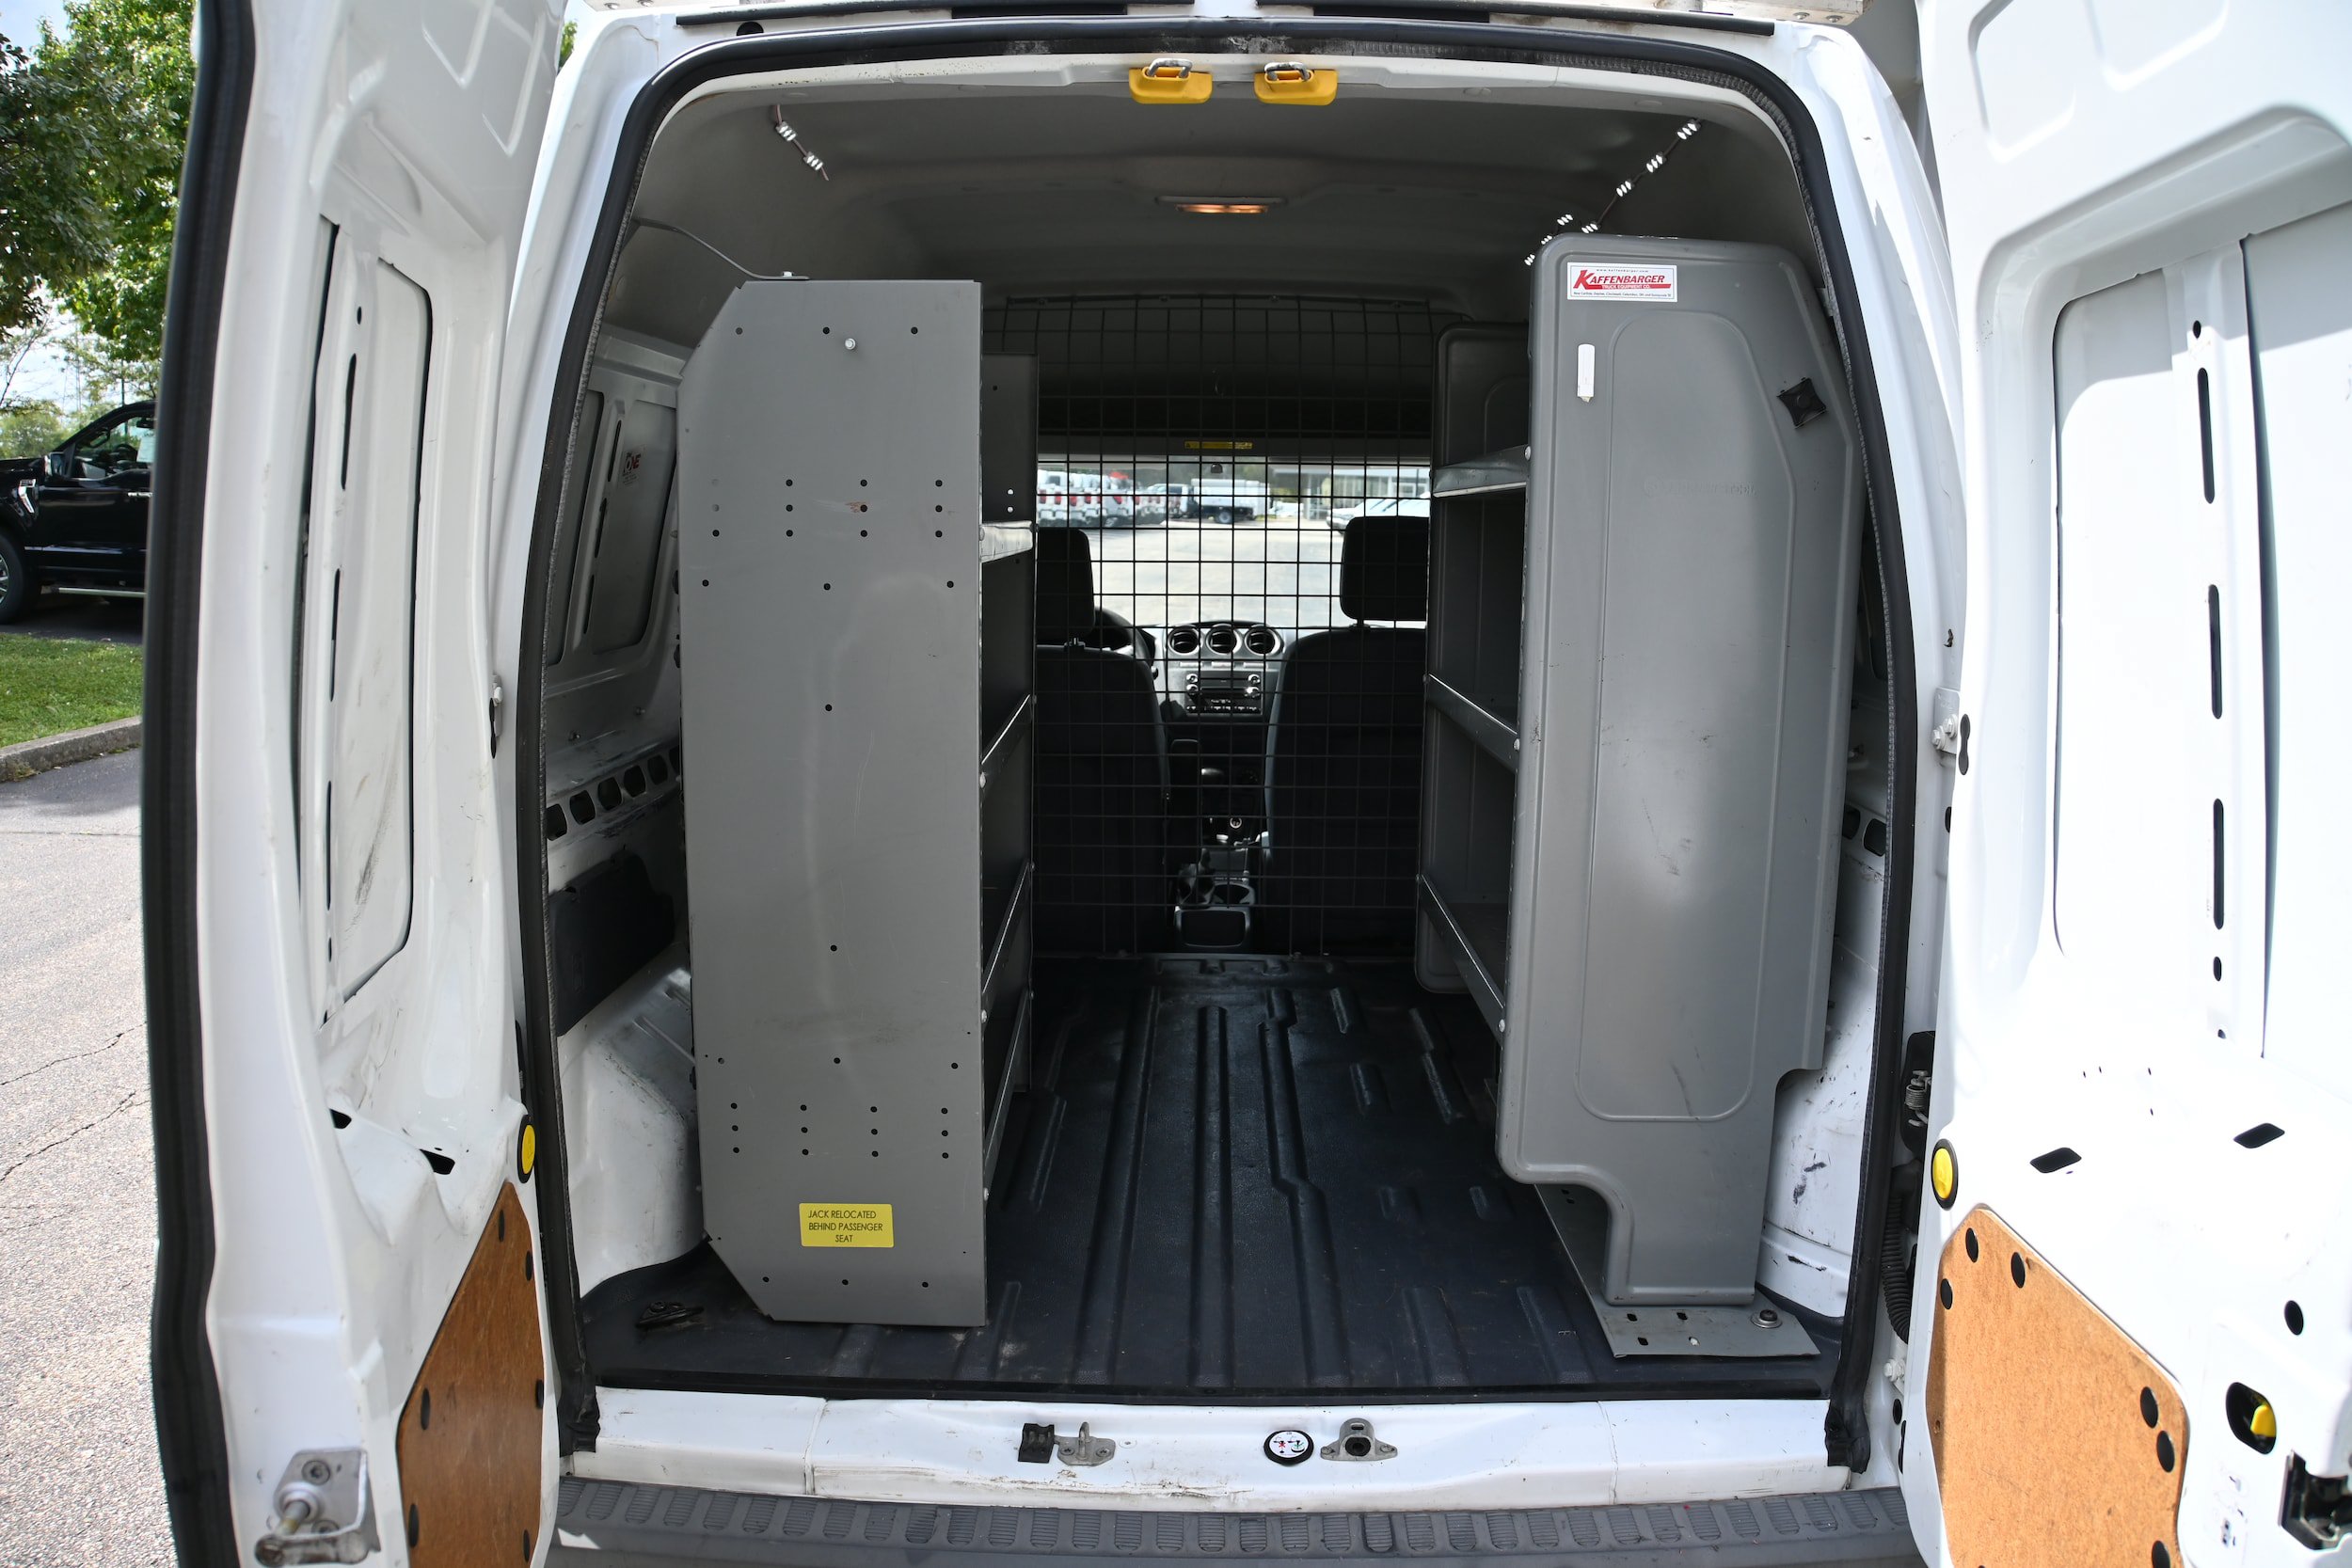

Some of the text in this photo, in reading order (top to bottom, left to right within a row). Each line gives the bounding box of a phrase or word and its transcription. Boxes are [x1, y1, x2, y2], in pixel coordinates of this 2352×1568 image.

[1573, 270, 1665, 290] KAFFENBARGER
[808, 1211, 876, 1219] JACK RELOCATED
[839, 1223, 882, 1231] PASSENGER
[834, 1234, 853, 1243] SEAT
